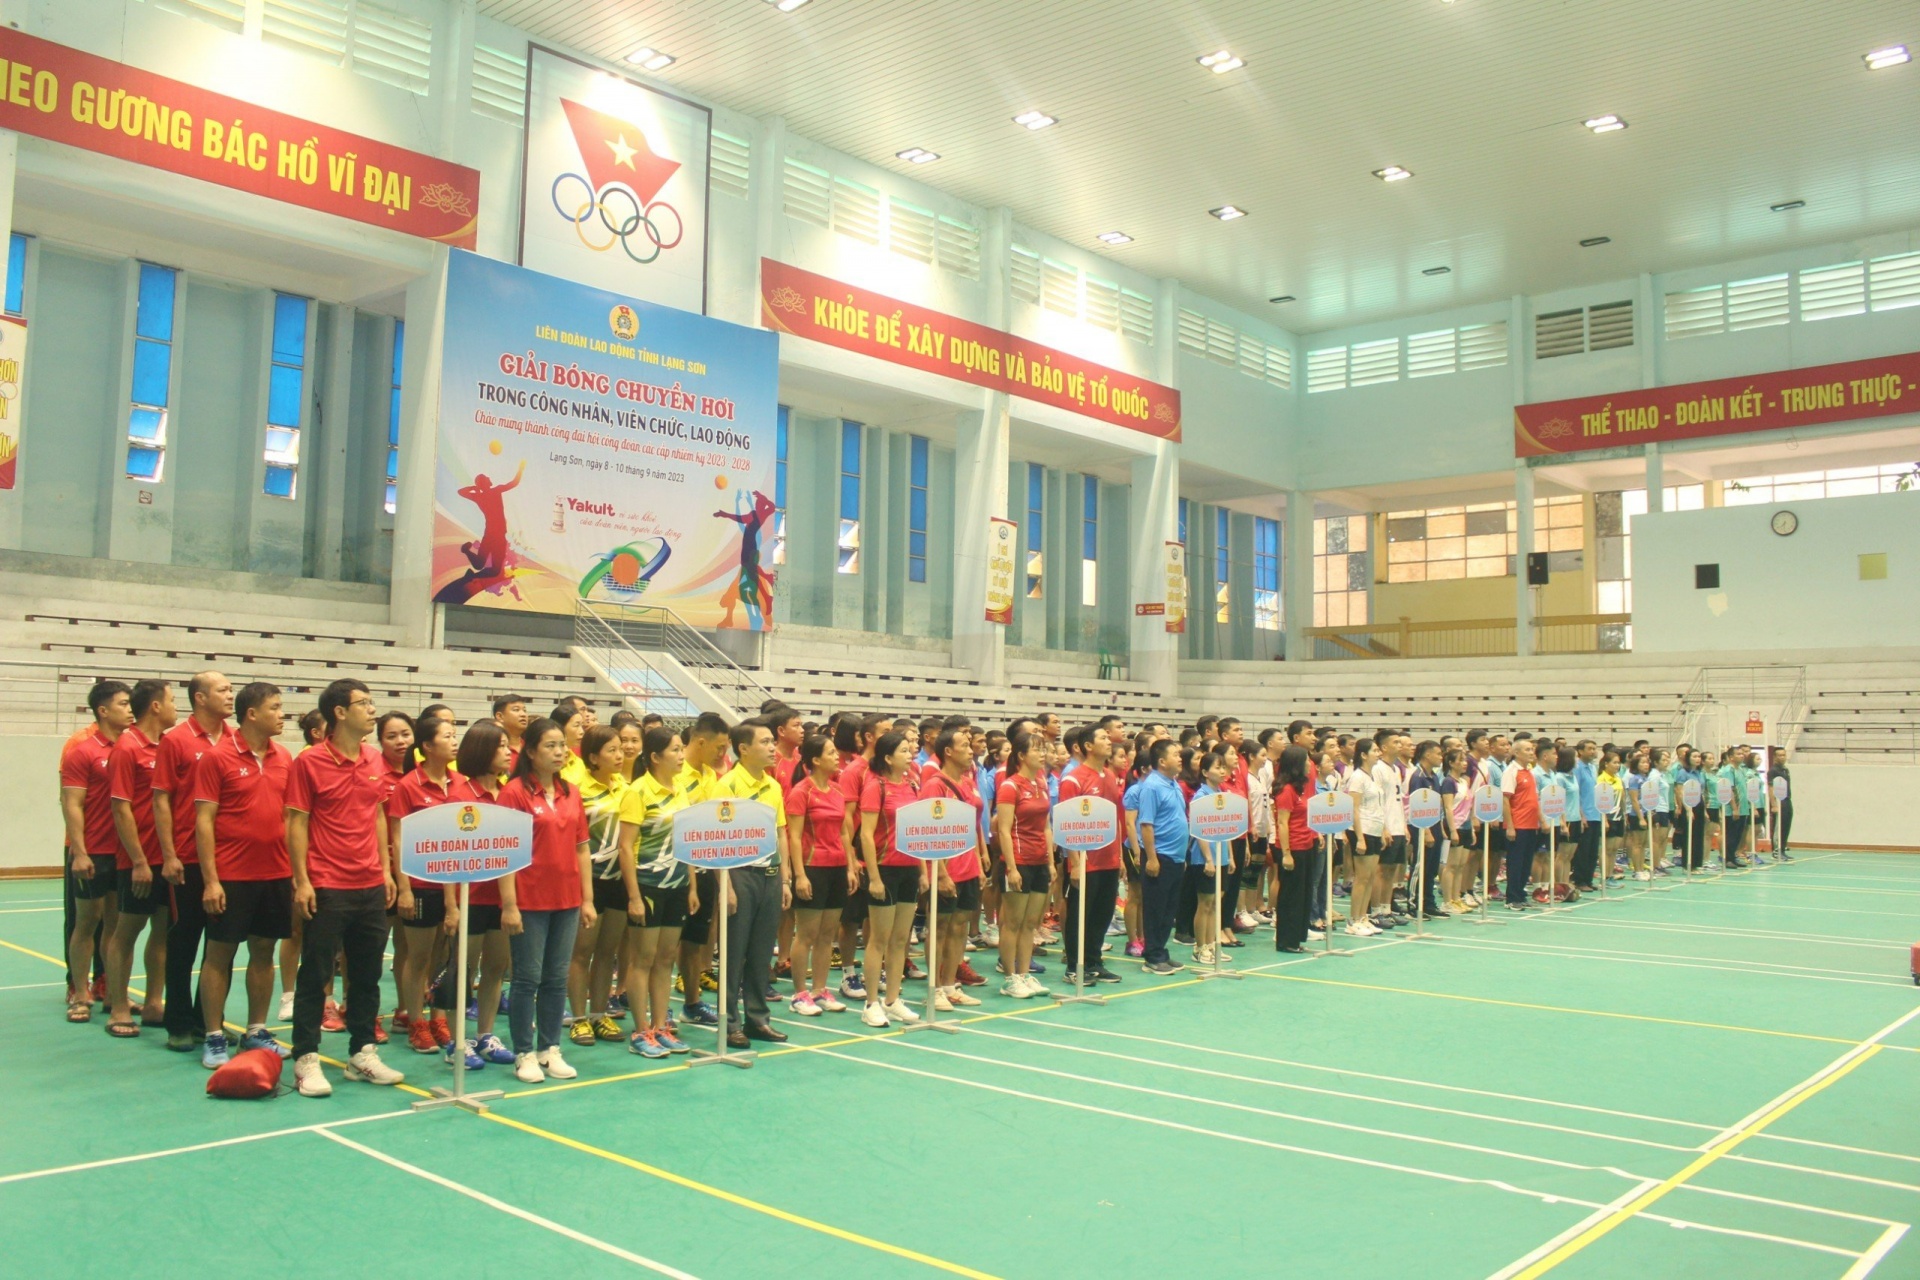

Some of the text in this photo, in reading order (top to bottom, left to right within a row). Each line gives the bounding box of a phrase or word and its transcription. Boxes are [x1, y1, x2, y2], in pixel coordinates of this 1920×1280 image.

[71, 81, 192, 152] GƯƠNG
[203, 119, 268, 171] BÁC
[277, 136, 319, 186] HỒ
[327, 152, 357, 197] VĨ
[363, 165, 412, 216] ĐẠI
[535, 325, 706, 375] LIÊN ĐOÀN LAO ĐỘNG TỈNH LẠNG SƠN
[814, 294, 1149, 420] KHỎE ĐỂ XÂY DỰNG VÀ BẢO VỆ TỔ QUỐC
[499, 350, 735, 420] GIẢI BÓNG CHUYỀN HƠI
[1581, 402, 1612, 438] THỂ
[1616, 406, 1659, 432] THAO
[1676, 395, 1725, 426] ĐOÀN
[1730, 385, 1763, 419] KẾT
[1781, 382, 1845, 413] TRUNG
[1850, 373, 1902, 407] THỰC
[474, 409, 496, 425] Chào
[524, 420, 549, 436] thành
[707, 453, 726, 467] 2023
[731, 457, 751, 472] 2028
[478, 382, 750, 451] TRONG CÔNG NHÂN, VIÊN CHỨC, LAO ĐỘNG
[549, 451, 568, 466] Lạng
[604, 461, 609, 470] 8
[616, 463, 624, 473] 10
[646, 468, 651, 477] 9
[668, 472, 685, 483] 2023
[567, 497, 616, 517] Yakult
[415, 835, 519, 854] LIÊN ĐOÀN LAO ĐỘNG
[728, 829, 742, 840] LAO
[426, 855, 508, 876] HUYỆN LỘC BÌNH
